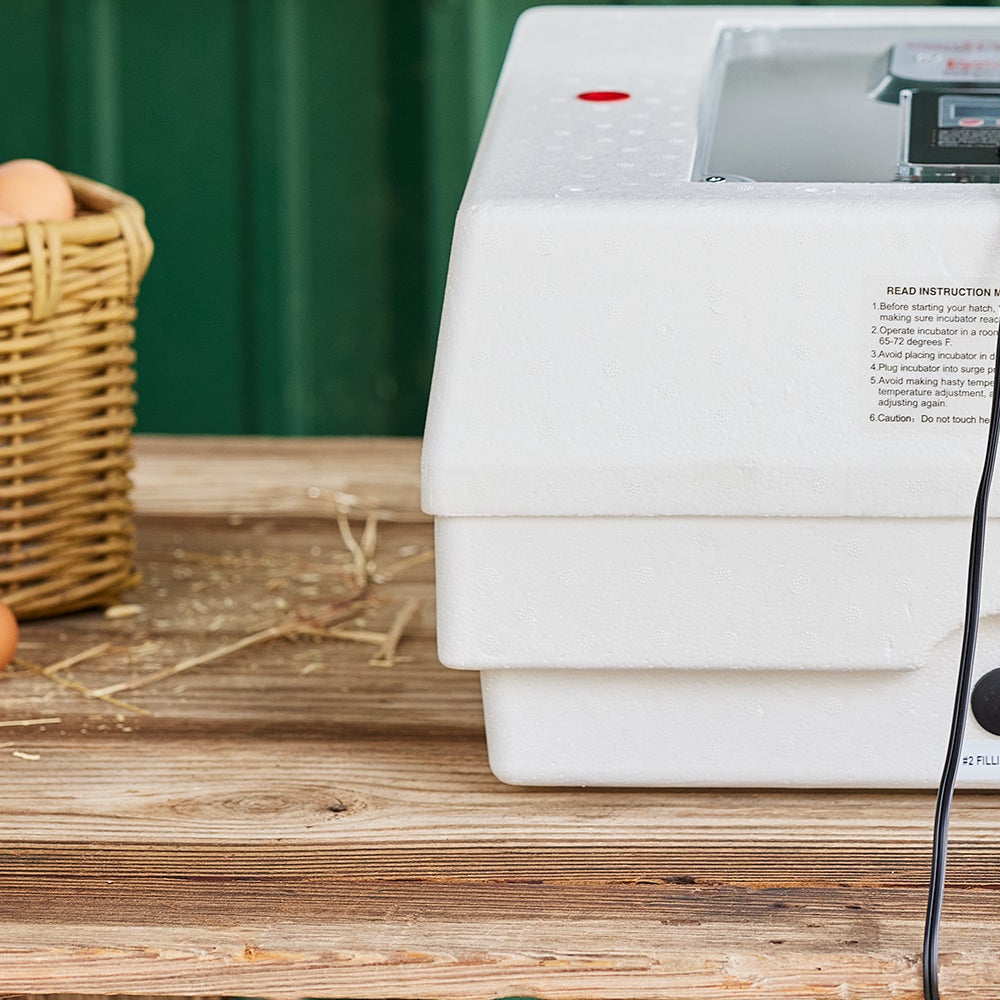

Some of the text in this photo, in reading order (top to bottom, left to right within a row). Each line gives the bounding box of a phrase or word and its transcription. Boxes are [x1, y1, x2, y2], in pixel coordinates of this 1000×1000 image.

[886, 286, 917, 295] READ
[919, 287, 991, 297] INSTRUCTION
[911, 303, 943, 312] starting
[879, 313, 912, 323] making
[936, 314, 977, 323] incubator
[917, 327, 958, 336] incubator
[960, 328, 969, 336] in
[879, 337, 904, 345] 65-72
[906, 338, 942, 347] degrees
[905, 350, 935, 361] placing
[937, 351, 977, 360] incubator
[979, 352, 987, 360] in
[900, 364, 940, 373] incubator
[942, 365, 959, 373] into
[961, 366, 985, 375] surge
[906, 377, 938, 387] making
[941, 378, 965, 388] hasty
[878, 387, 933, 396] temperature
[878, 398, 918, 409] adjusting
[921, 414, 934, 423] Do
[936, 415, 950, 423] not
[952, 415, 976, 424] touch
[962, 756, 974, 766] #2
